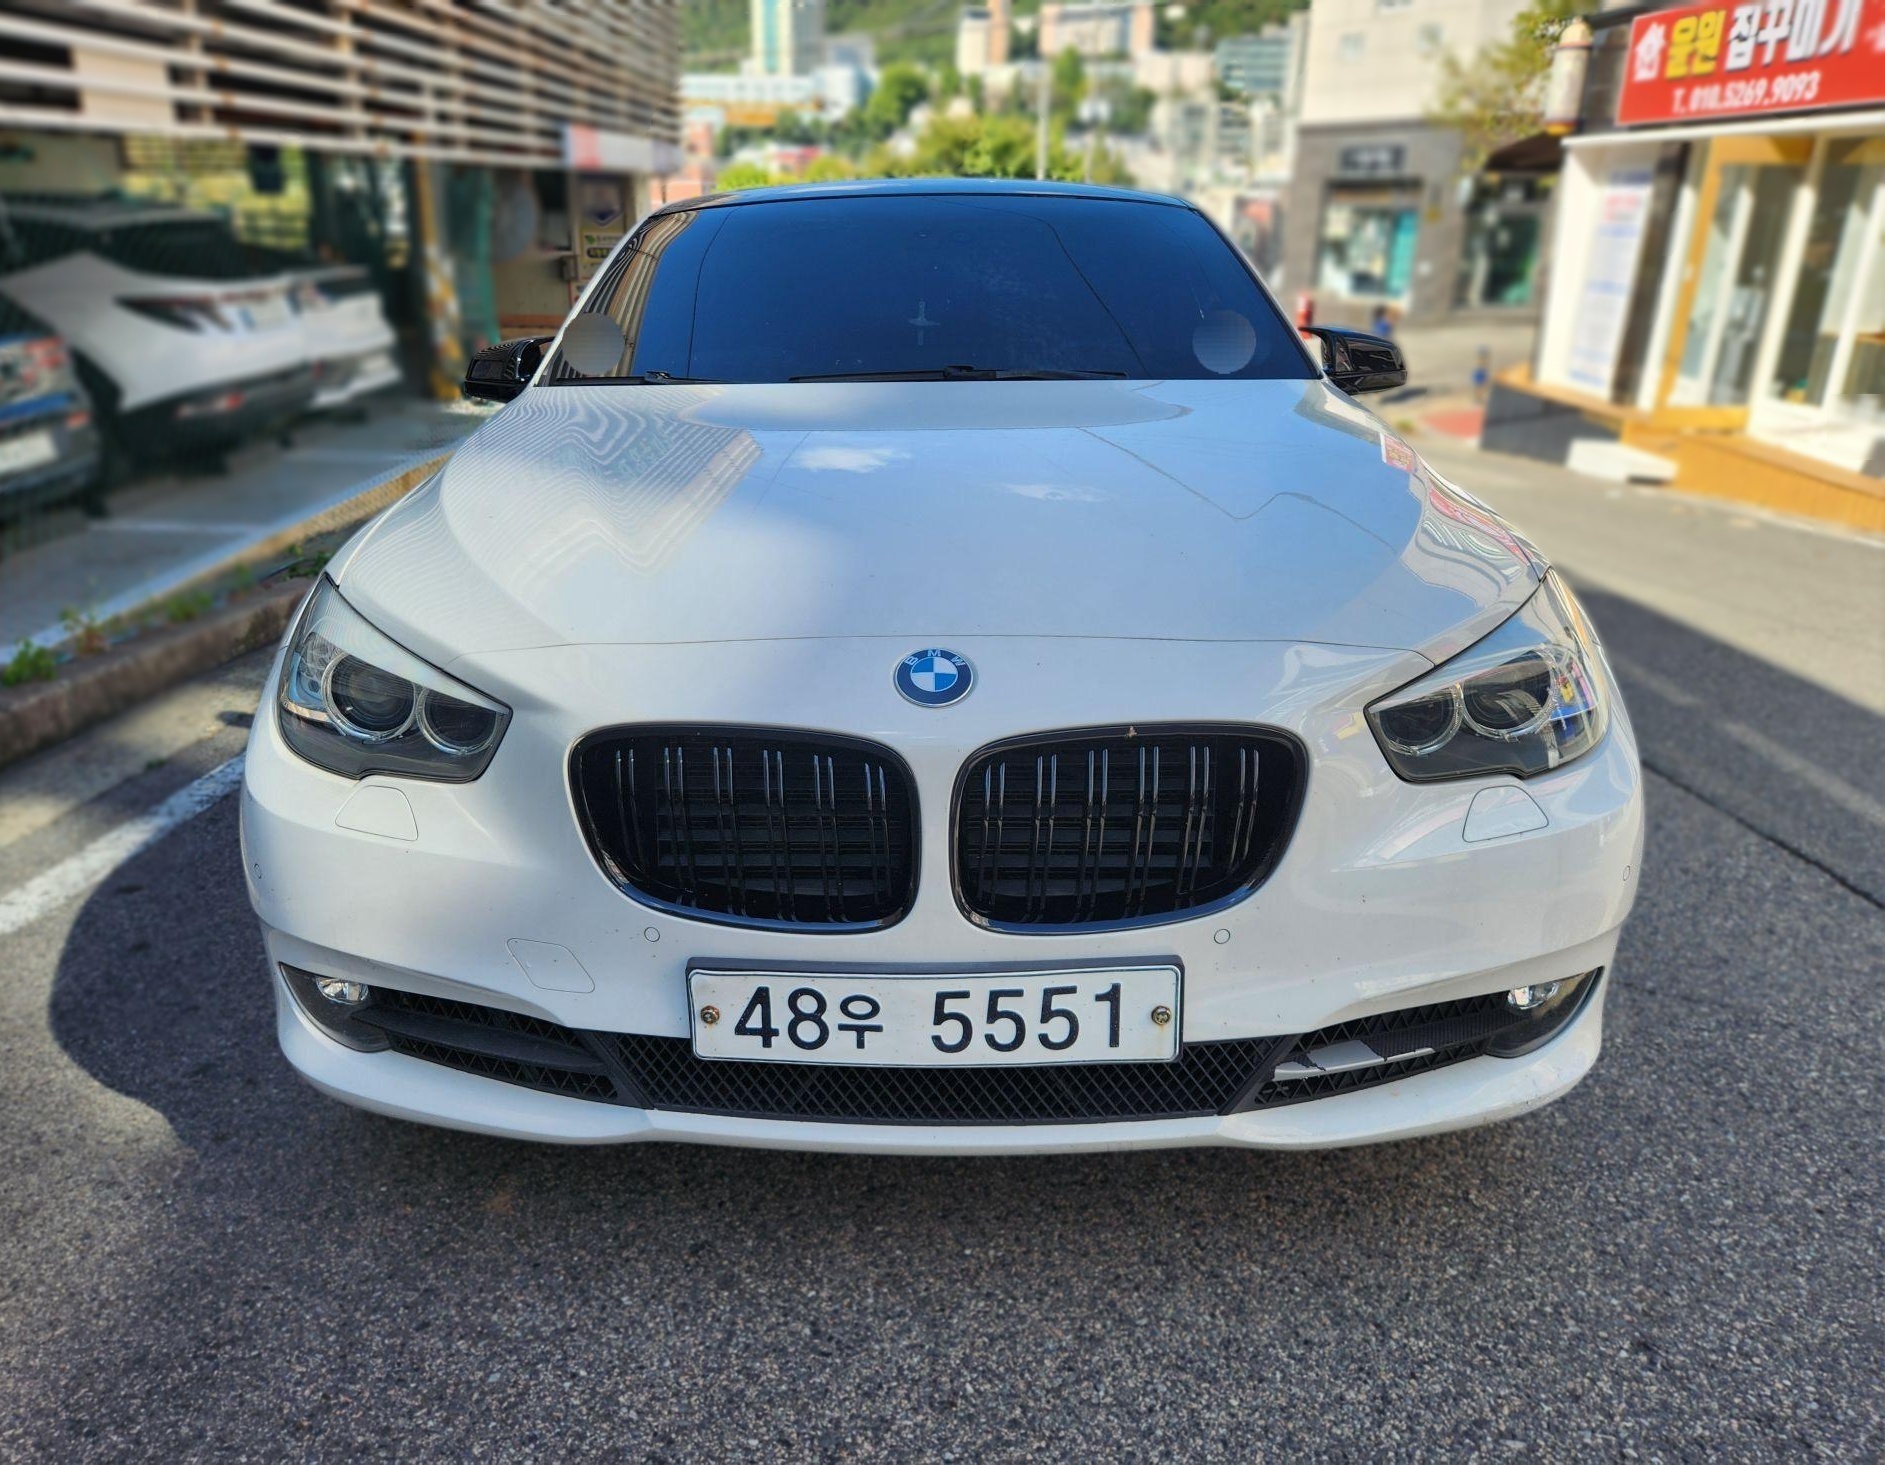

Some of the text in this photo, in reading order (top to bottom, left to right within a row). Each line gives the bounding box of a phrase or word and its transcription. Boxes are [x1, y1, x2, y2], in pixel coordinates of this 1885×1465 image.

[1725, 0, 1864, 71] 집꾸미기
[904, 649, 966, 666] BMW
[735, 983, 1121, 1054] 48우 5551
